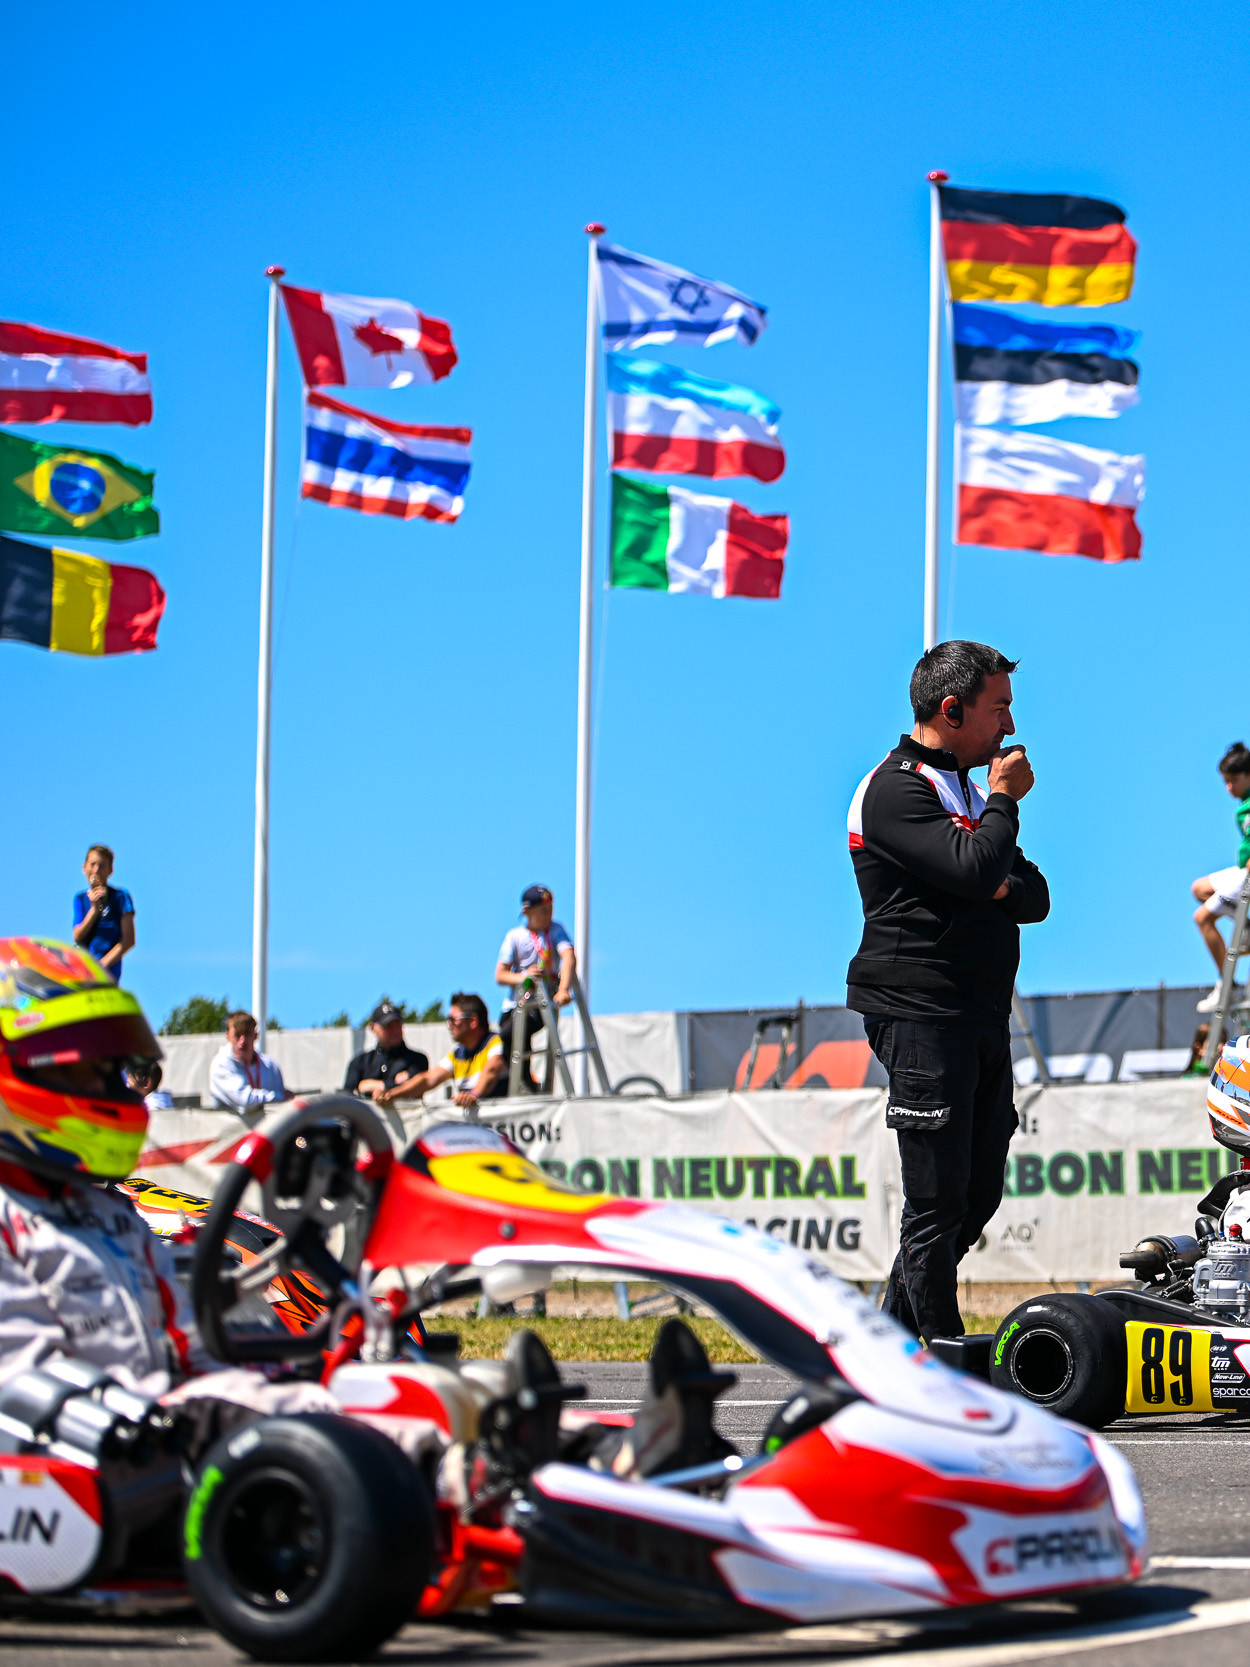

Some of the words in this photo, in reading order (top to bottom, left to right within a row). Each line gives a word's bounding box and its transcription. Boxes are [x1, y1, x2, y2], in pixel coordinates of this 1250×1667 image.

[653, 1155, 866, 1199] NEUTRAL
[994, 1321, 1020, 1366] VEGA
[1141, 1327, 1193, 1407] 89
